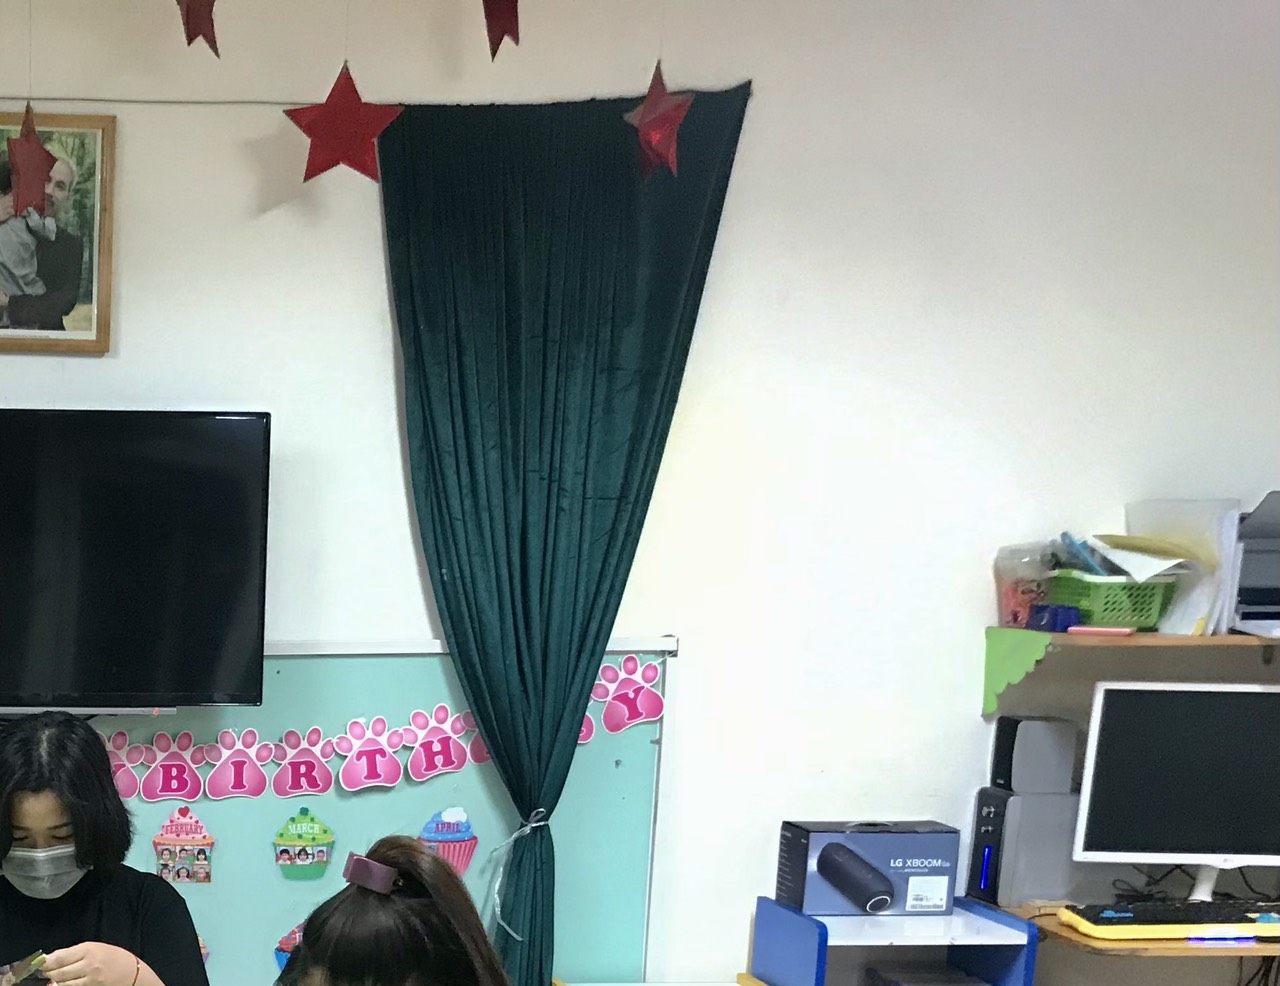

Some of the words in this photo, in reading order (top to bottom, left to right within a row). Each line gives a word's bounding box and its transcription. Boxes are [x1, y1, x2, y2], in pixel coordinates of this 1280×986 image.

[165, 823, 204, 835] FEBRUARY
[288, 823, 320, 835] MARCH
[434, 821, 462, 833] APRIL
[890, 858, 903, 867] LG
[905, 858, 942, 868] XBOOM
